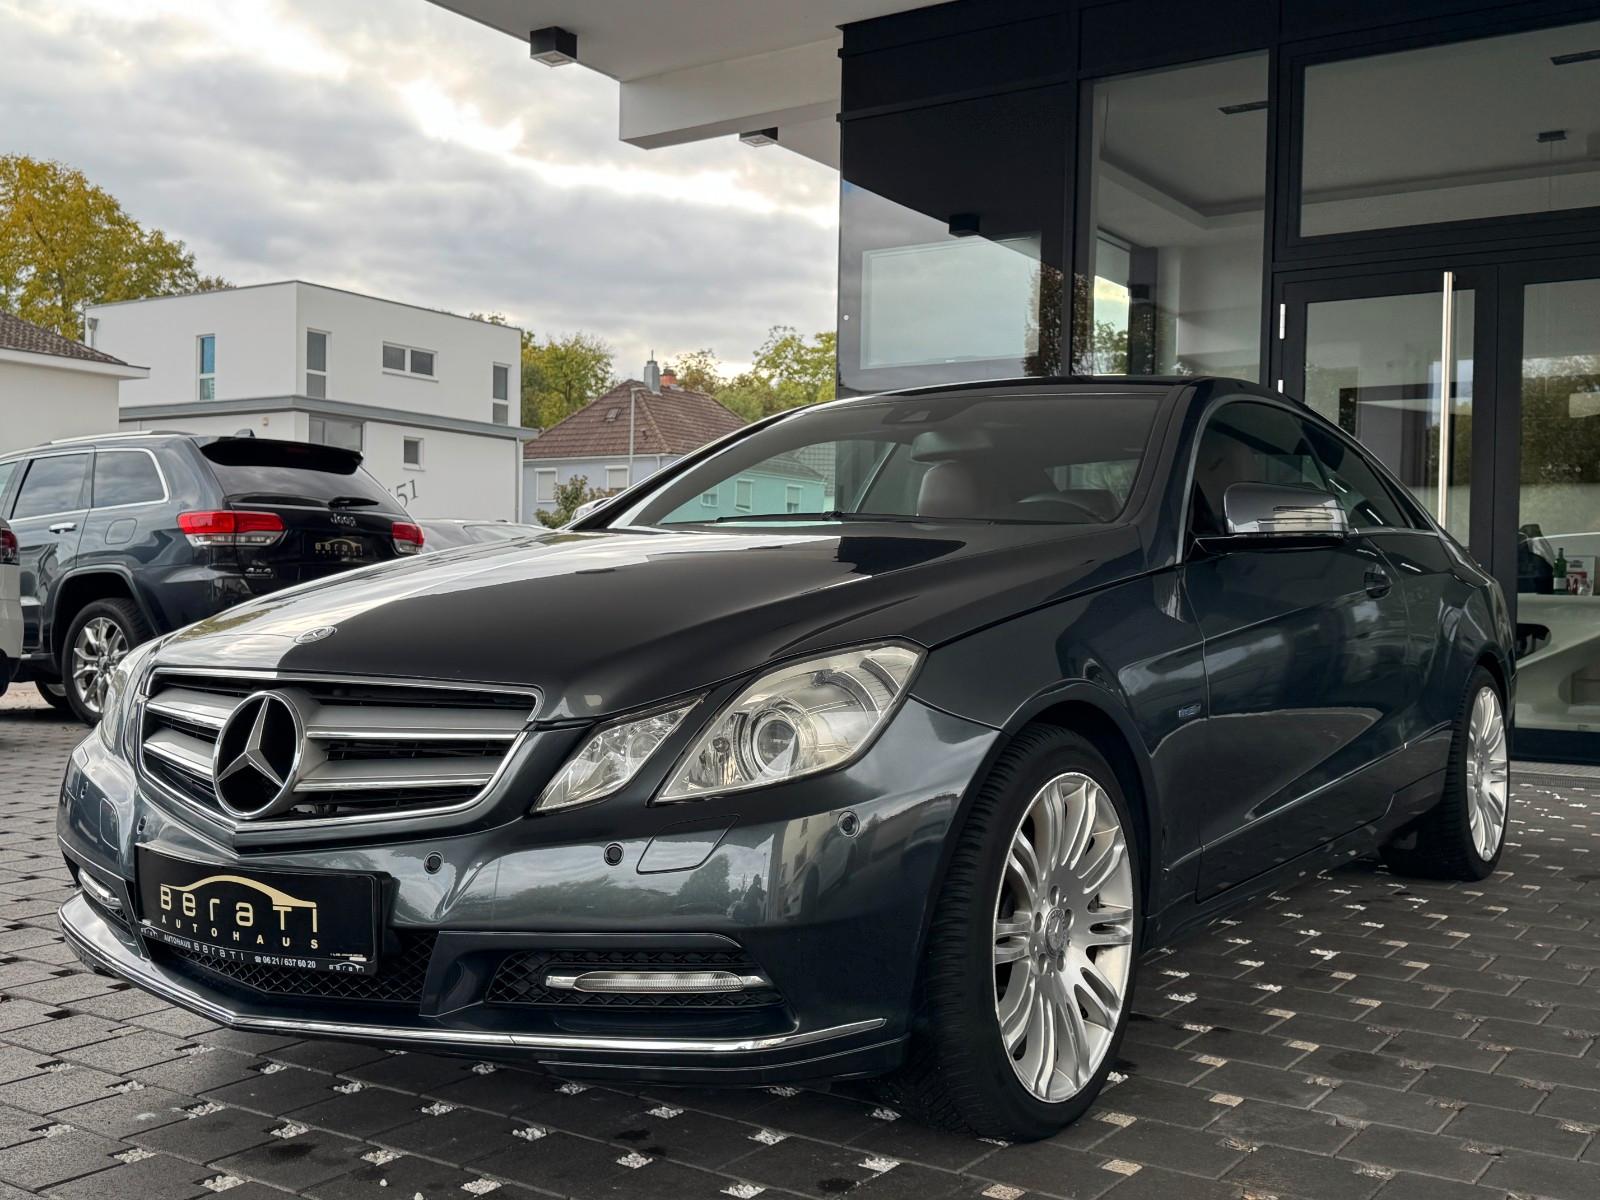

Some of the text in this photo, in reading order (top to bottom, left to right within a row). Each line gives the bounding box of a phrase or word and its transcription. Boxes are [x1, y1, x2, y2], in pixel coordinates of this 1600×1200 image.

[388, 479, 419, 508] 51
[161, 914, 319, 949] AUTOHAUS
[271, 956, 280, 965] 21
[284, 958, 297, 967] 637
[307, 960, 317, 969] 20
